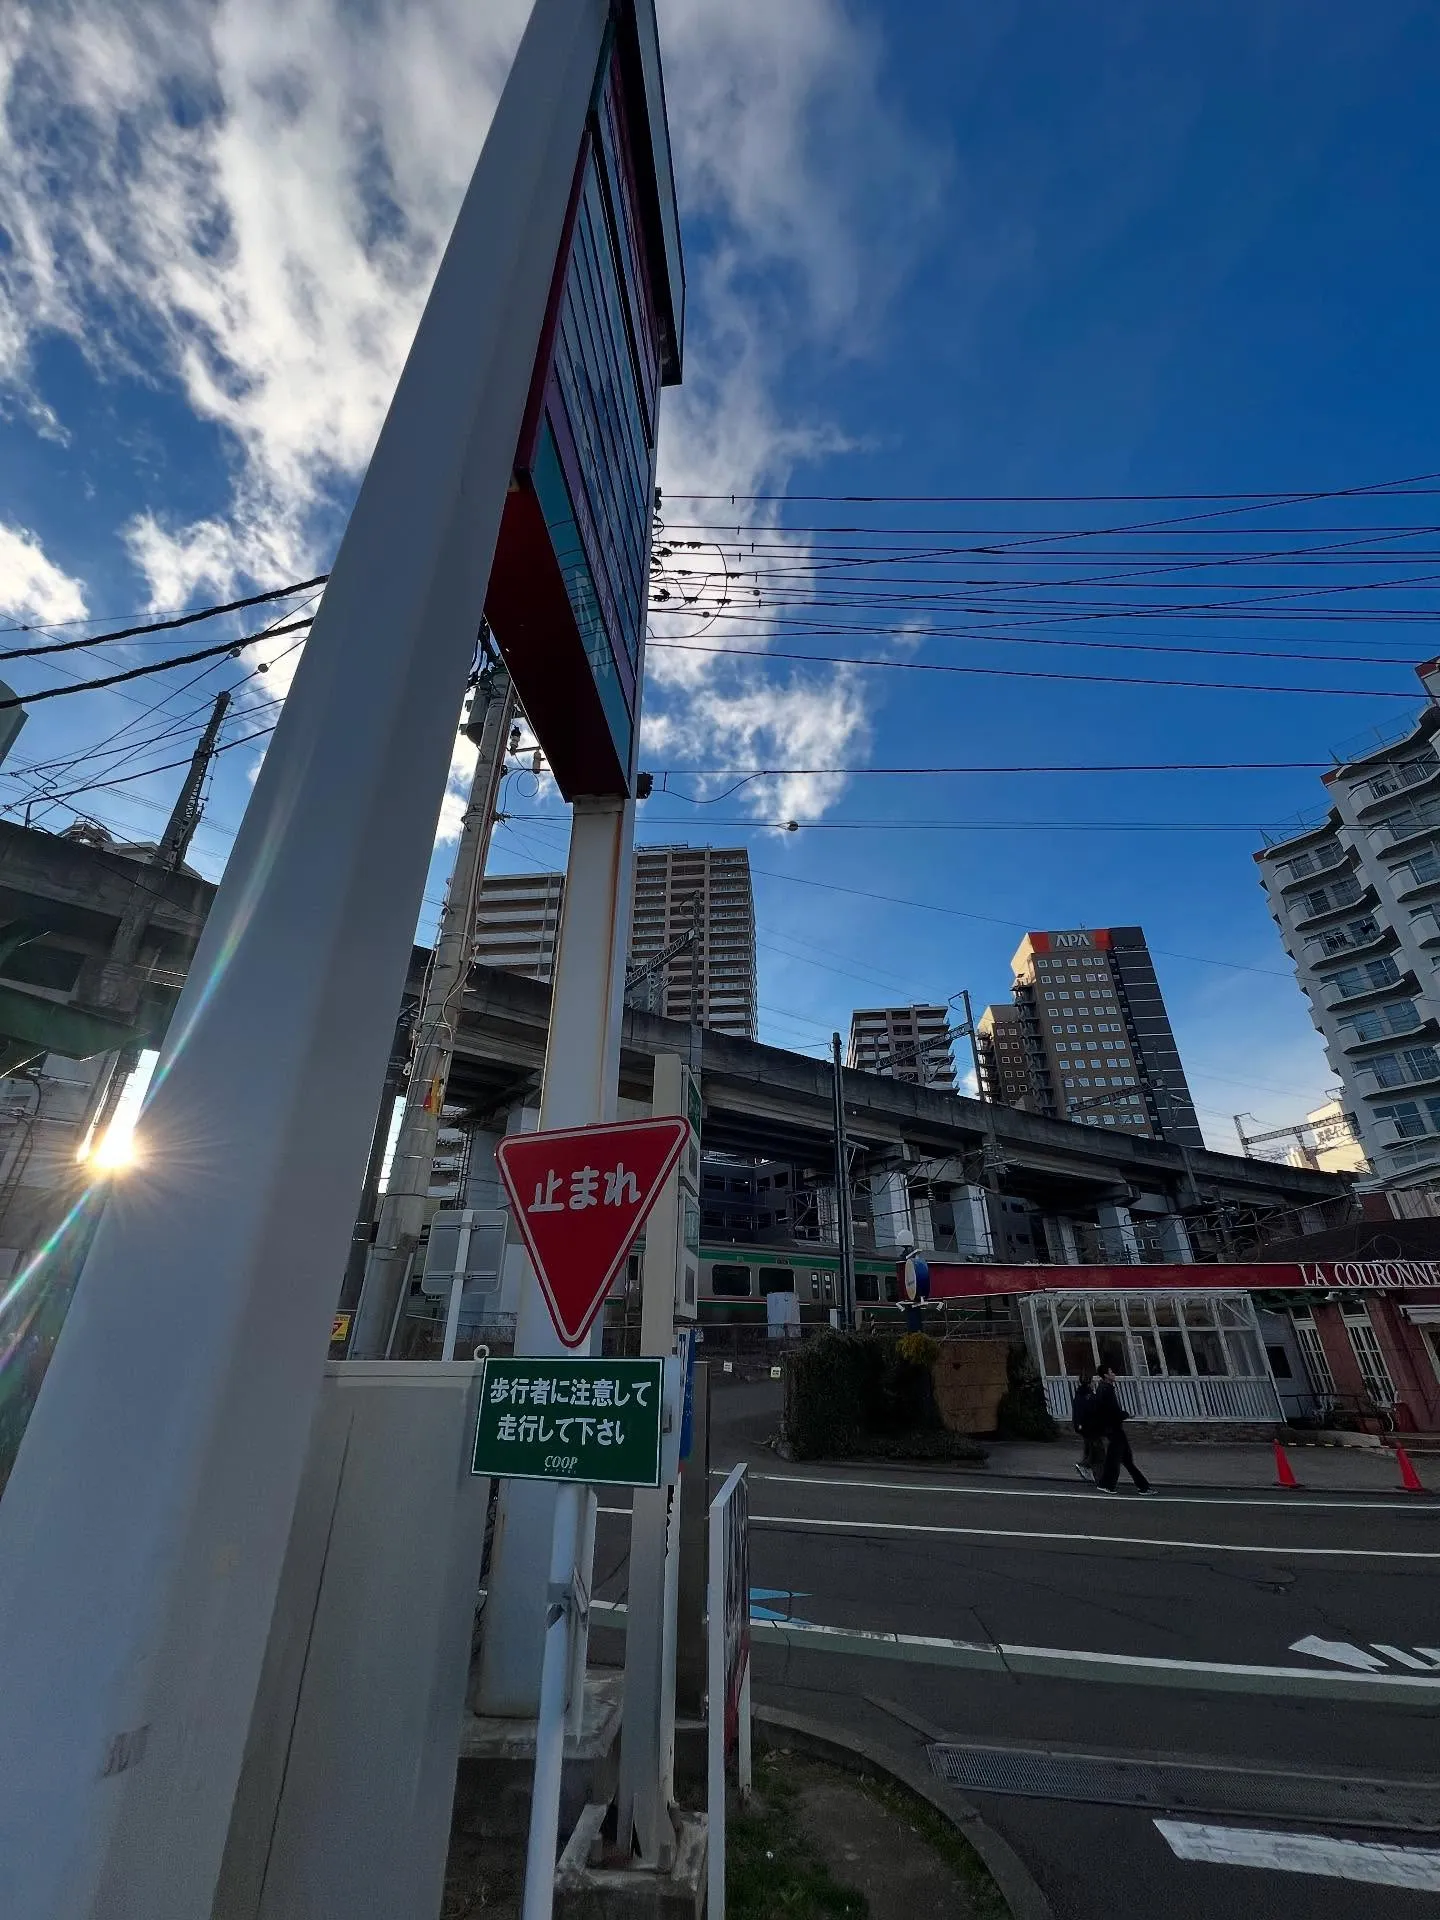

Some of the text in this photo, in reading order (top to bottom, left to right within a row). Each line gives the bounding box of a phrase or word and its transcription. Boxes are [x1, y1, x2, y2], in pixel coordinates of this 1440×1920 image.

[1056, 933, 1090, 947] APA
[527, 1162, 641, 1212] 止まれ
[1298, 1263, 1330, 1286] LA
[490, 1377, 652, 1407] 歩行者に注意して
[496, 1413, 626, 1446] 走行して下さい
[544, 1455, 579, 1470] COOP
